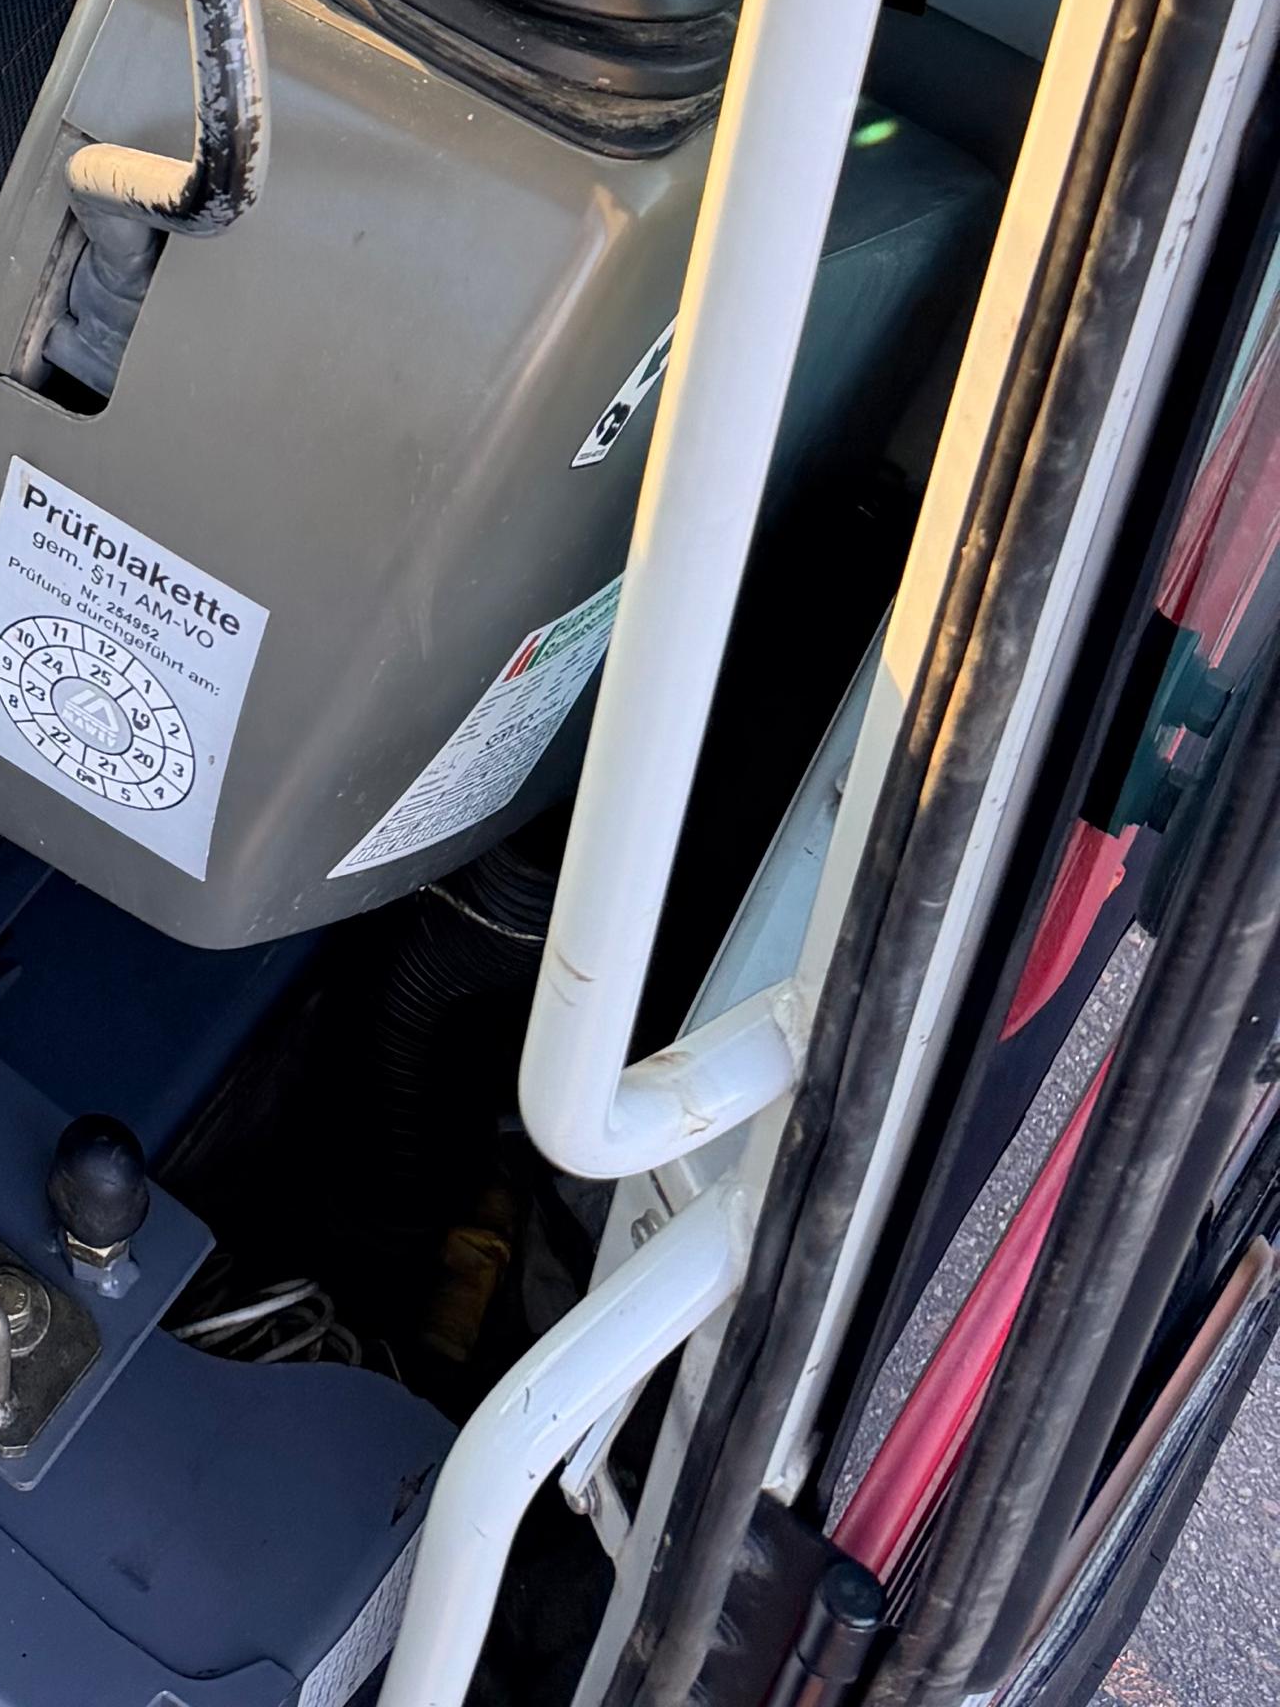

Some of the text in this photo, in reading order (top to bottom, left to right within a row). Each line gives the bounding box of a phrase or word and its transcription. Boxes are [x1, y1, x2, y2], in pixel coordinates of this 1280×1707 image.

[23, 484, 241, 637] Prüfplakette
[31, 528, 215, 652] gem. §11 AM-VO
[80, 583, 160, 642] Nr. 254952
[7, 555, 220, 698] Prüfung durchgeführt am:
[14, 626, 35, 650] 10
[50, 620, 68, 643] 11
[96, 638, 117, 663] 12
[1, 654, 12, 671] 9
[40, 651, 63, 675] 24
[89, 662, 112, 688] 25
[142, 678, 151, 695] 1
[8, 693, 19, 709] 8
[24, 679, 45, 702] 23
[129, 706, 151, 732] 19
[167, 720, 181, 740] 2
[34, 732, 45, 748] 7
[49, 724, 72, 748] 22
[97, 754, 117, 776] 21
[132, 746, 154, 769] 20
[172, 761, 184, 778] 3
[120, 786, 131, 803] 5
[153, 784, 165, 799] 4
